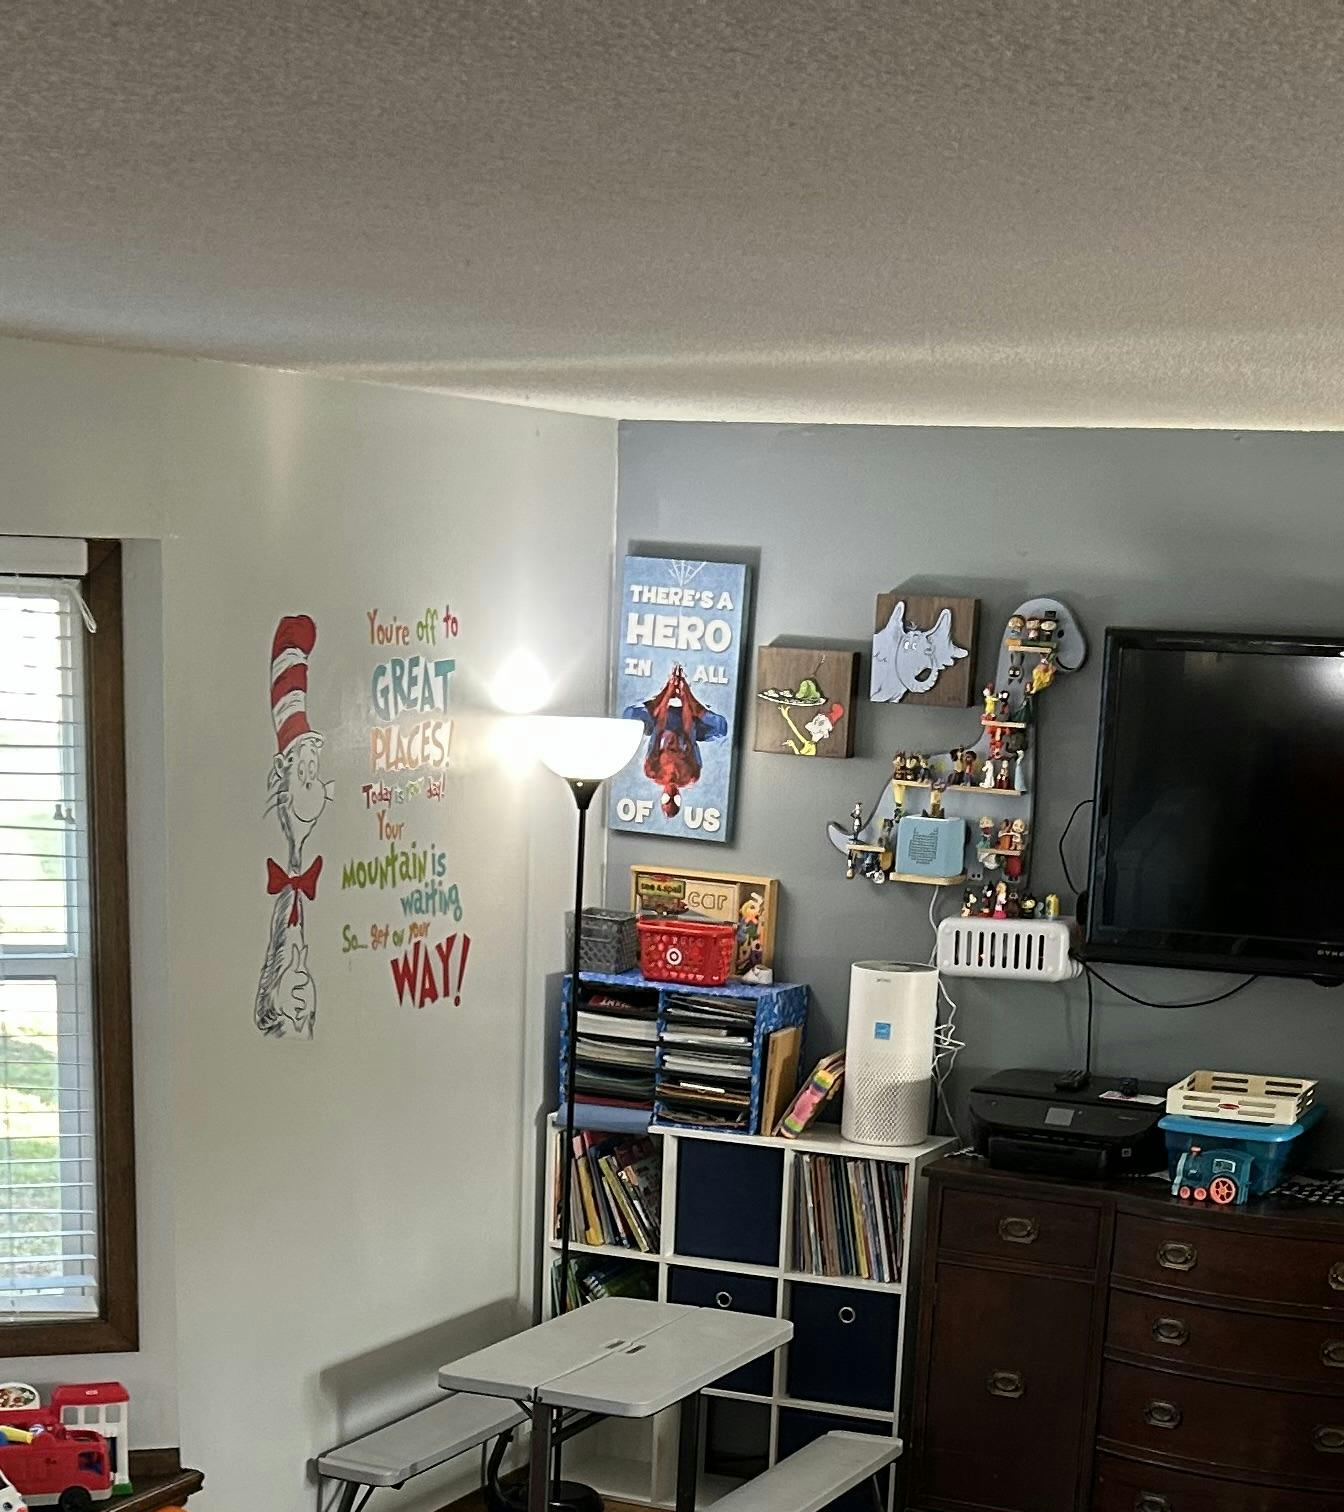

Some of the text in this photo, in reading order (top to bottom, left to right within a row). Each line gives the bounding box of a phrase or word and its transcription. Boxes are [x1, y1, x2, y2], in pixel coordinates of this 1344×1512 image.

[630, 584, 734, 611] THERE'S A
[367, 604, 459, 646] You're off to
[626, 612, 732, 653] HERO
[371, 656, 456, 721] GREAT
[624, 658, 729, 685] IN ALL
[370, 719, 455, 776] PLACES!
[361, 779, 393, 809] Today
[376, 809, 405, 841] Your
[616, 798, 721, 832] OF US
[430, 843, 447, 878] is
[400, 879, 463, 922] waiting
[687, 890, 729, 911] car
[370, 923, 389, 951] get
[390, 932, 472, 1010] WAY!
